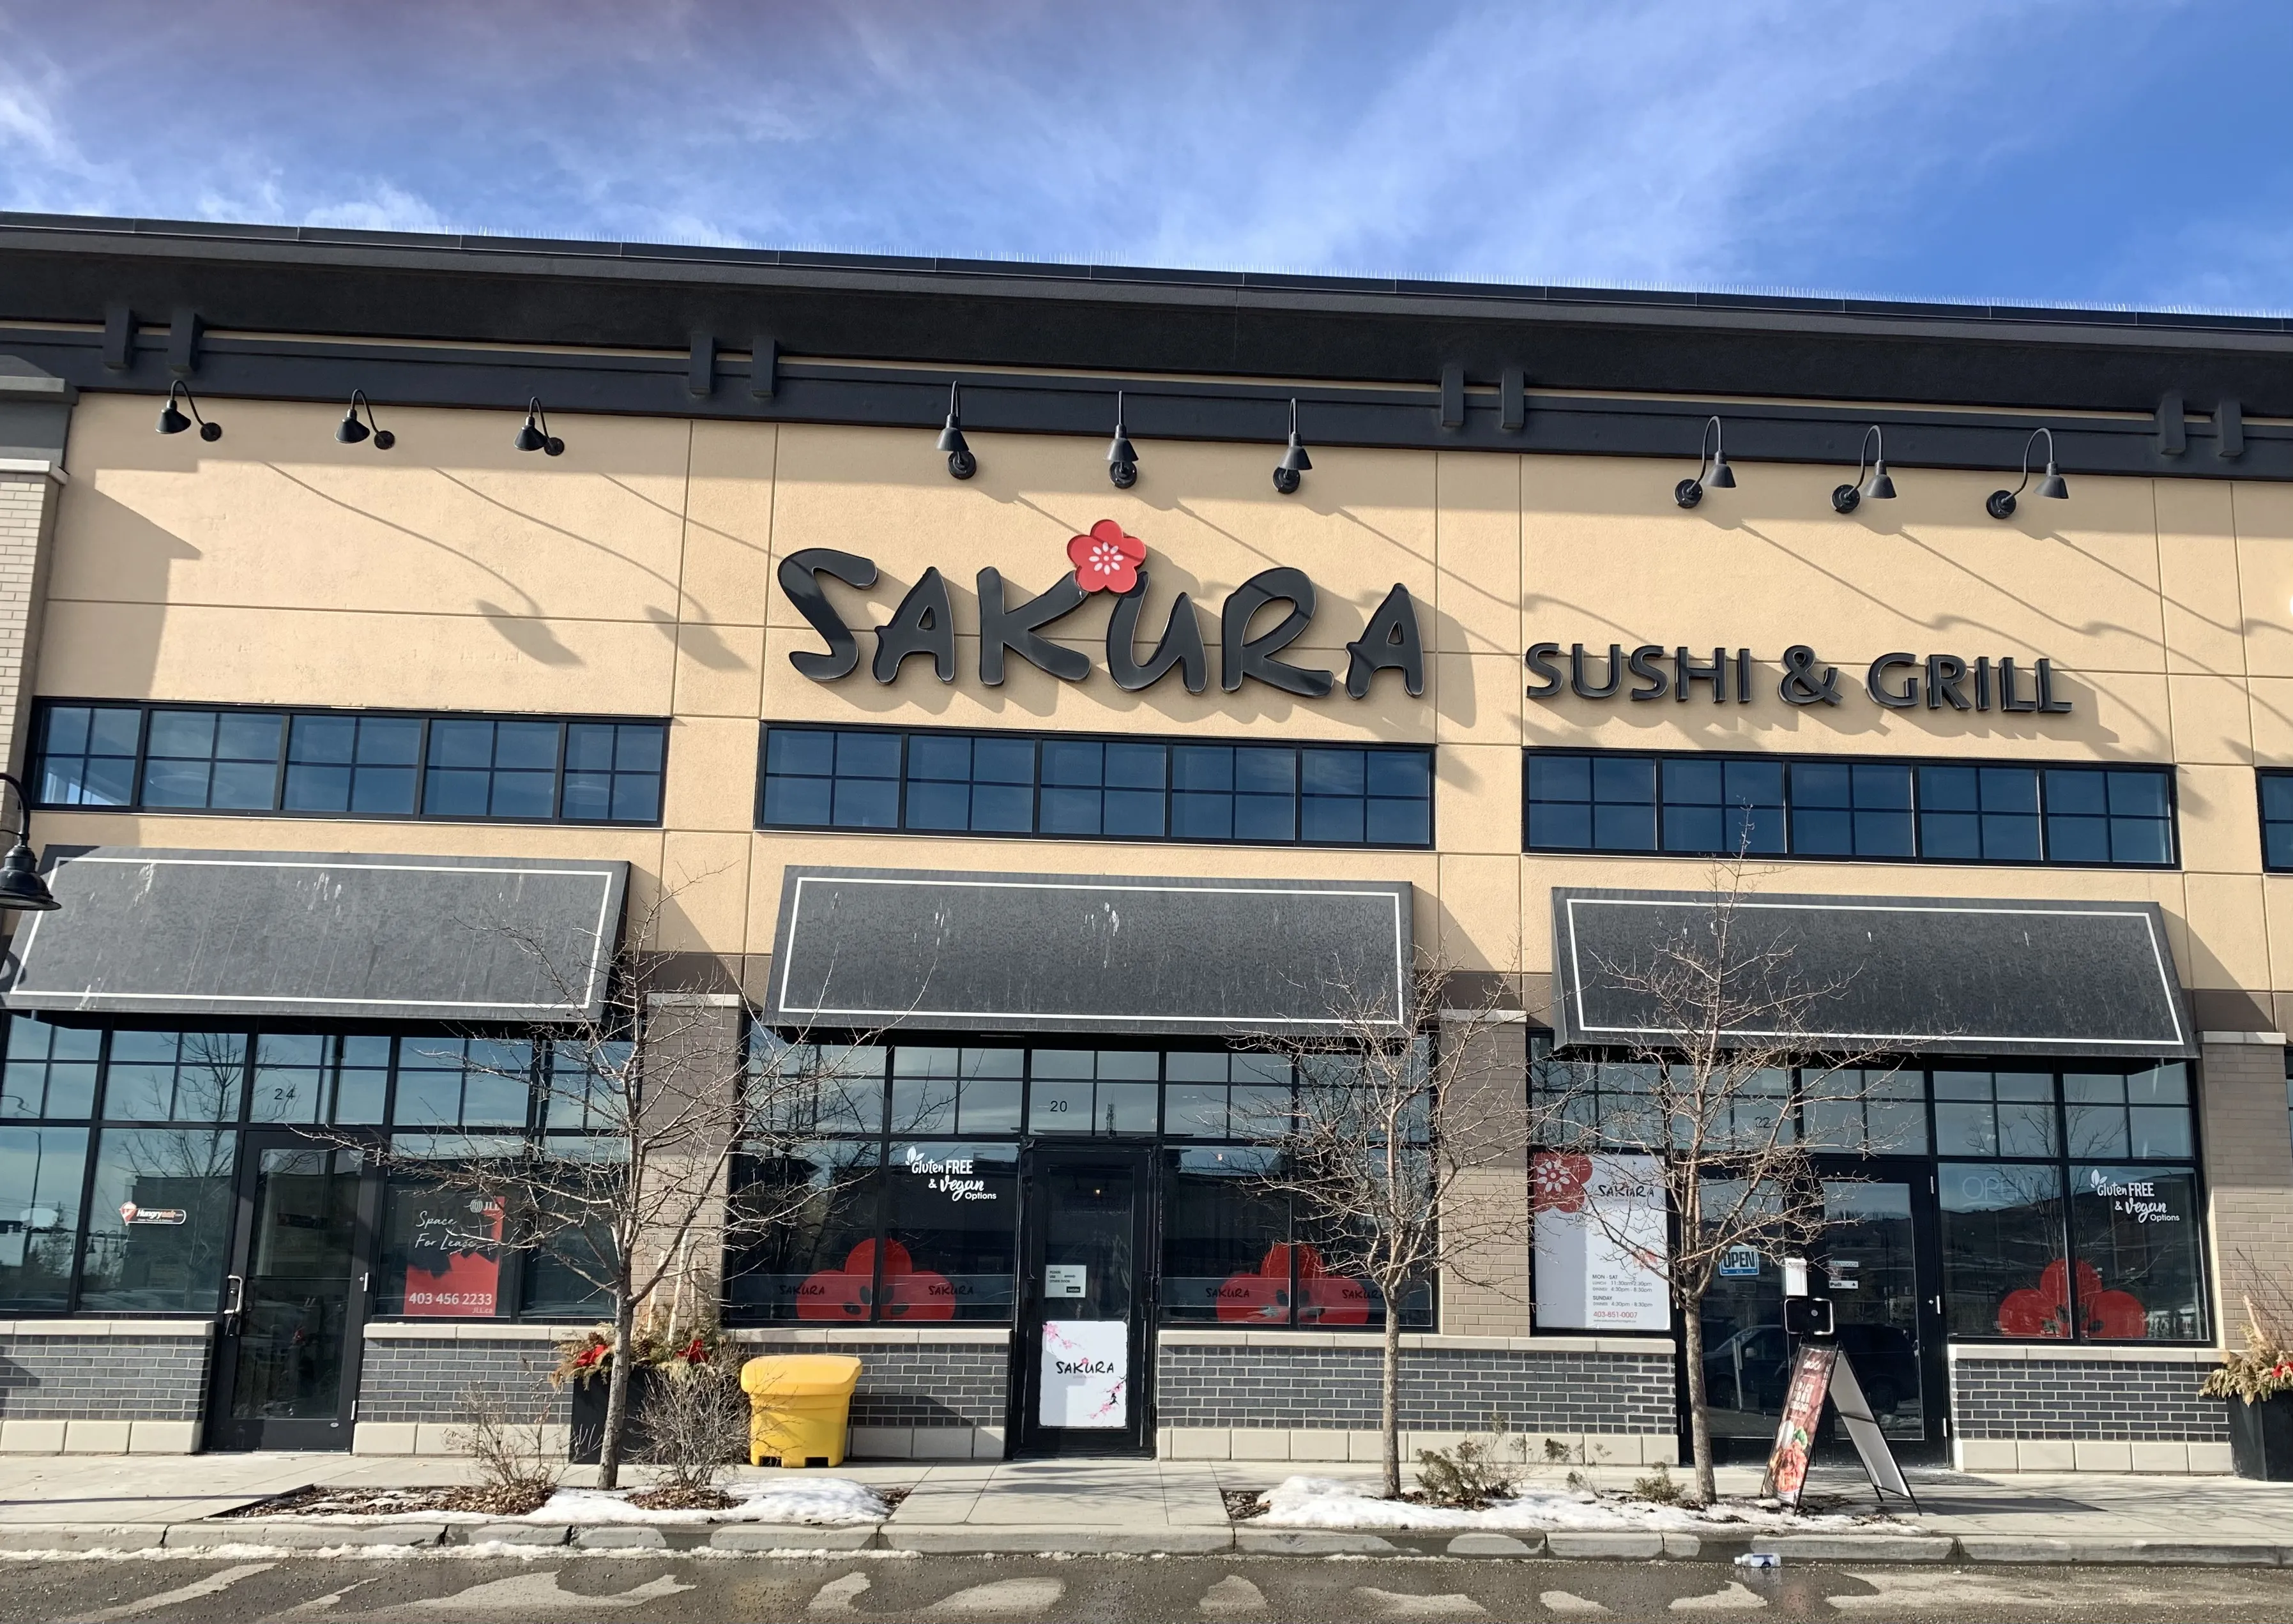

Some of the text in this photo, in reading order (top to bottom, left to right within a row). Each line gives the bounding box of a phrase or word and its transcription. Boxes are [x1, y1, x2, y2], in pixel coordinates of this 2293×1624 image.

[777, 547, 1426, 701] SAKURA
[1525, 642, 2074, 714] SUSHI & GRILL
[274, 1088, 296, 1100] 24
[1050, 1100, 1067, 1112] 20
[1755, 1116, 1770, 1128] 22
[911, 1158, 973, 1174] Gluten FREE
[928, 1175, 984, 1201] & Vegan
[2097, 1182, 2155, 1197] Gluten FREE
[964, 1192, 997, 1201] Options
[2114, 1197, 2167, 1223] & Vegan
[416, 1211, 455, 1229] Space
[2150, 1214, 2180, 1222] Options
[415, 1233, 476, 1250] For Lease
[1725, 1251, 1755, 1268] OPEN
[779, 1284, 825, 1295] SAKURA
[928, 1285, 974, 1295] SAKURA
[1206, 1287, 1250, 1298] SAKURA
[409, 1293, 492, 1305] 403 456 2233
[1056, 1361, 1114, 1374] SAKURA
